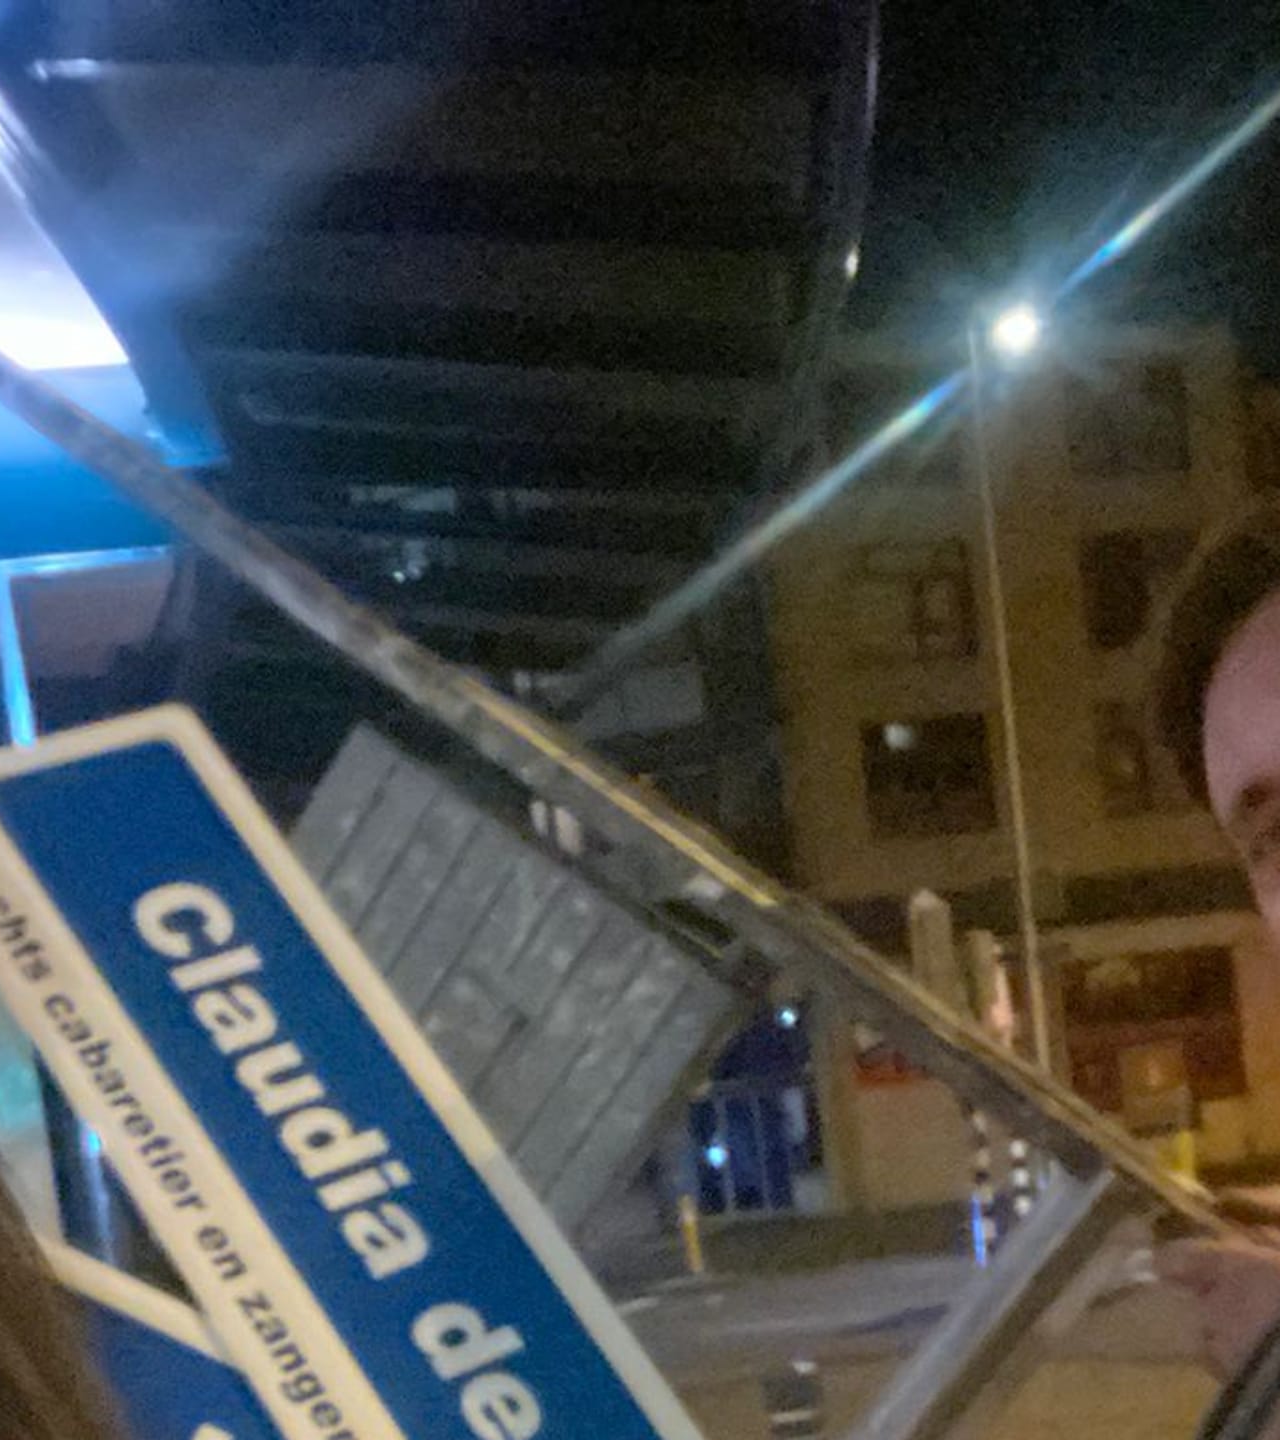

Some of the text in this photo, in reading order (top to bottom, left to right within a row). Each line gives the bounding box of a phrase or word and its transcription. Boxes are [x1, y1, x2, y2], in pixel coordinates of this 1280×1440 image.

[44, 992, 207, 1231] cabaretier
[195, 1222, 249, 1284] en
[132, 881, 431, 1281] Claudia
